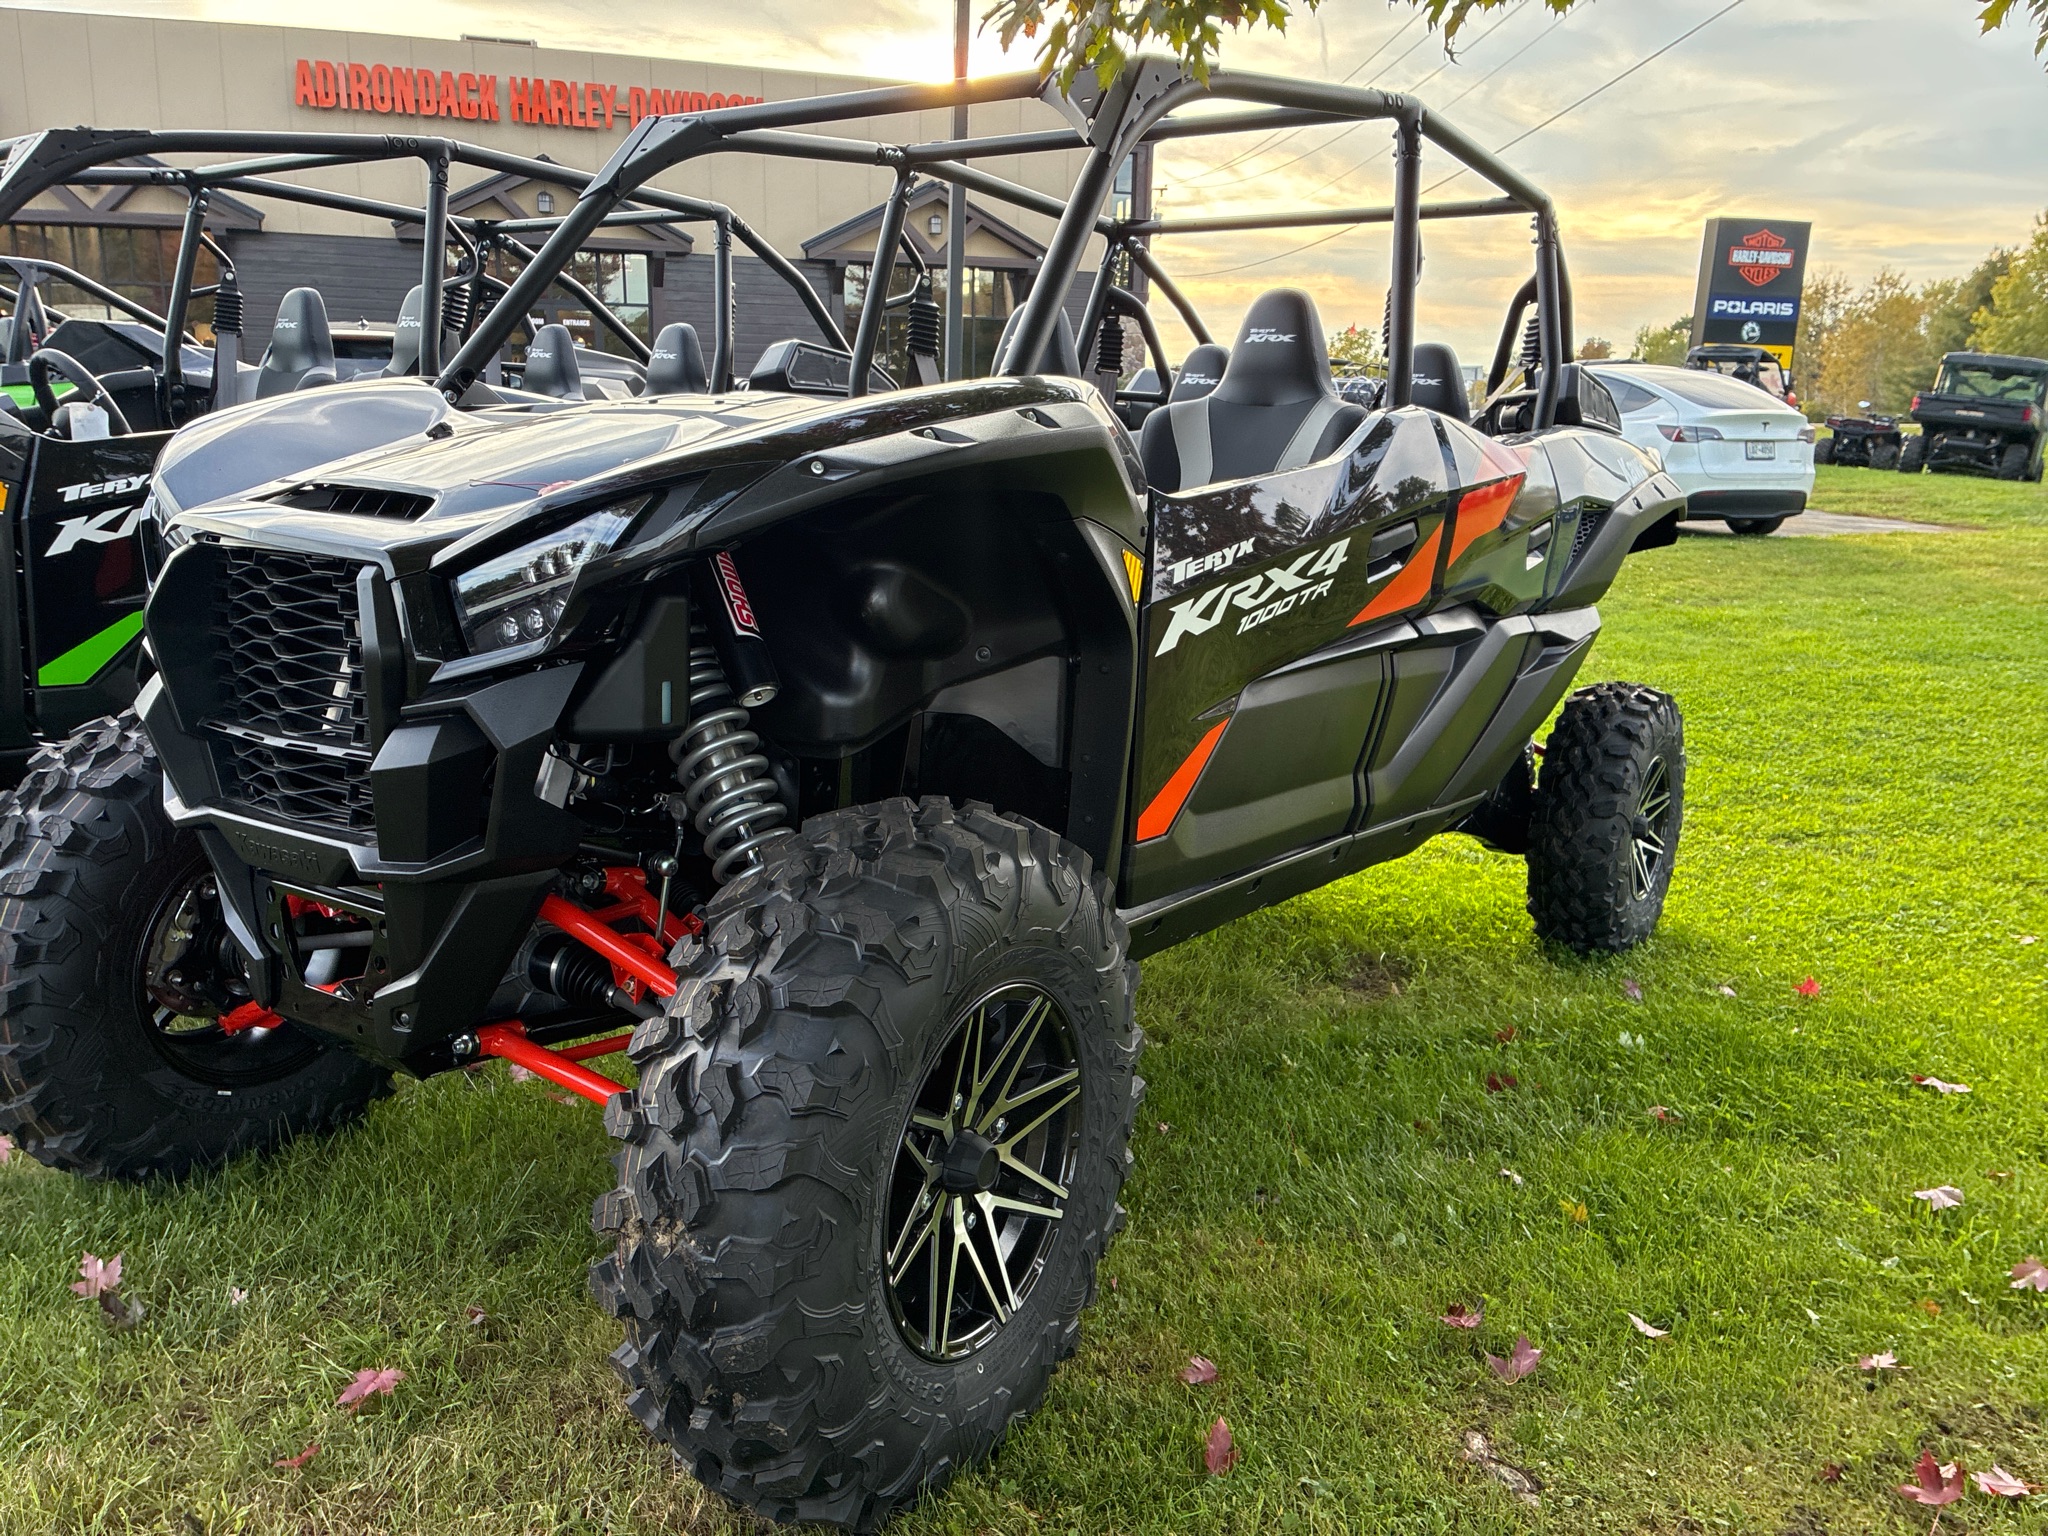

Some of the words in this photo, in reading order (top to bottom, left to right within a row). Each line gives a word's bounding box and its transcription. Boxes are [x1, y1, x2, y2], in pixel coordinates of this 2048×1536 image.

[295, 59, 500, 122] ADIRONDACK
[1713, 299, 1794, 316] POLARIS
[1244, 334, 1297, 344] KRX
[57, 473, 152, 503] TERY
[1166, 537, 1256, 585] TERYX
[1155, 537, 1351, 658] KRX4
[1236, 593, 1299, 636] 1000
[1300, 578, 1335, 606] TR
